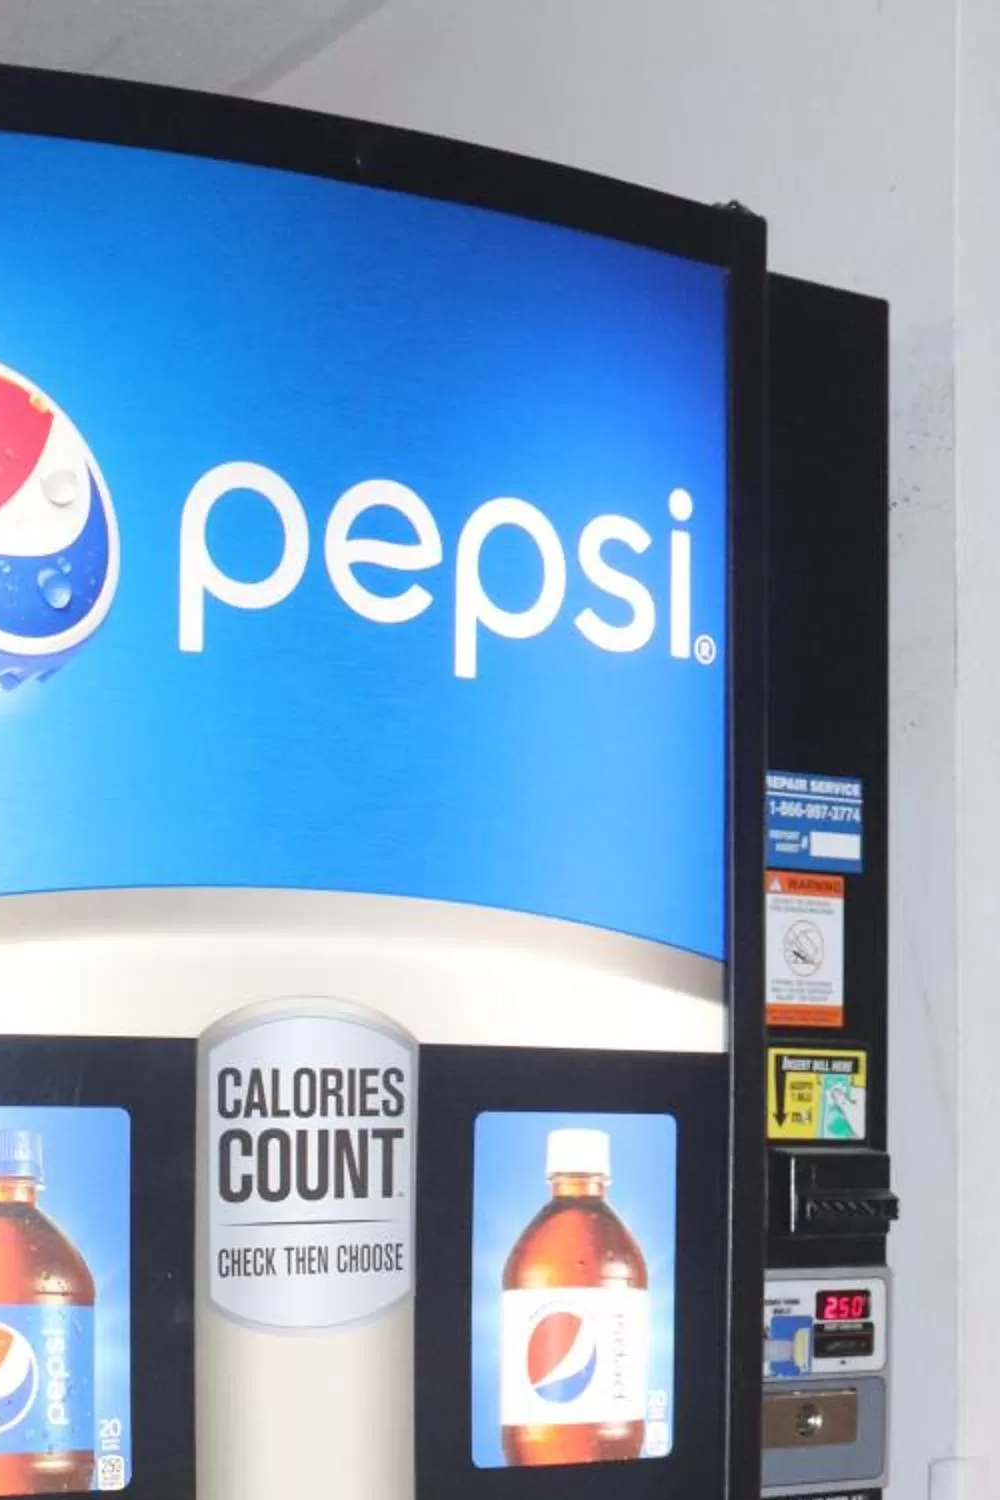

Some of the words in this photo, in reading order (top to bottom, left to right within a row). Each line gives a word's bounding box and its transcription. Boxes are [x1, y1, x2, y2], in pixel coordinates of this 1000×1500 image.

[179, 461, 693, 678] pepsi
[810, 780, 861, 797] SERVICE
[217, 1066, 405, 1120] CALORIES
[218, 1127, 405, 1203] COUNT
[218, 1247, 277, 1278] CHECK
[284, 1244, 329, 1276] THEN
[336, 1242, 404, 1273] CHOOSE
[41, 1328, 70, 1425] pepsi
[99, 1418, 122, 1437] 20
